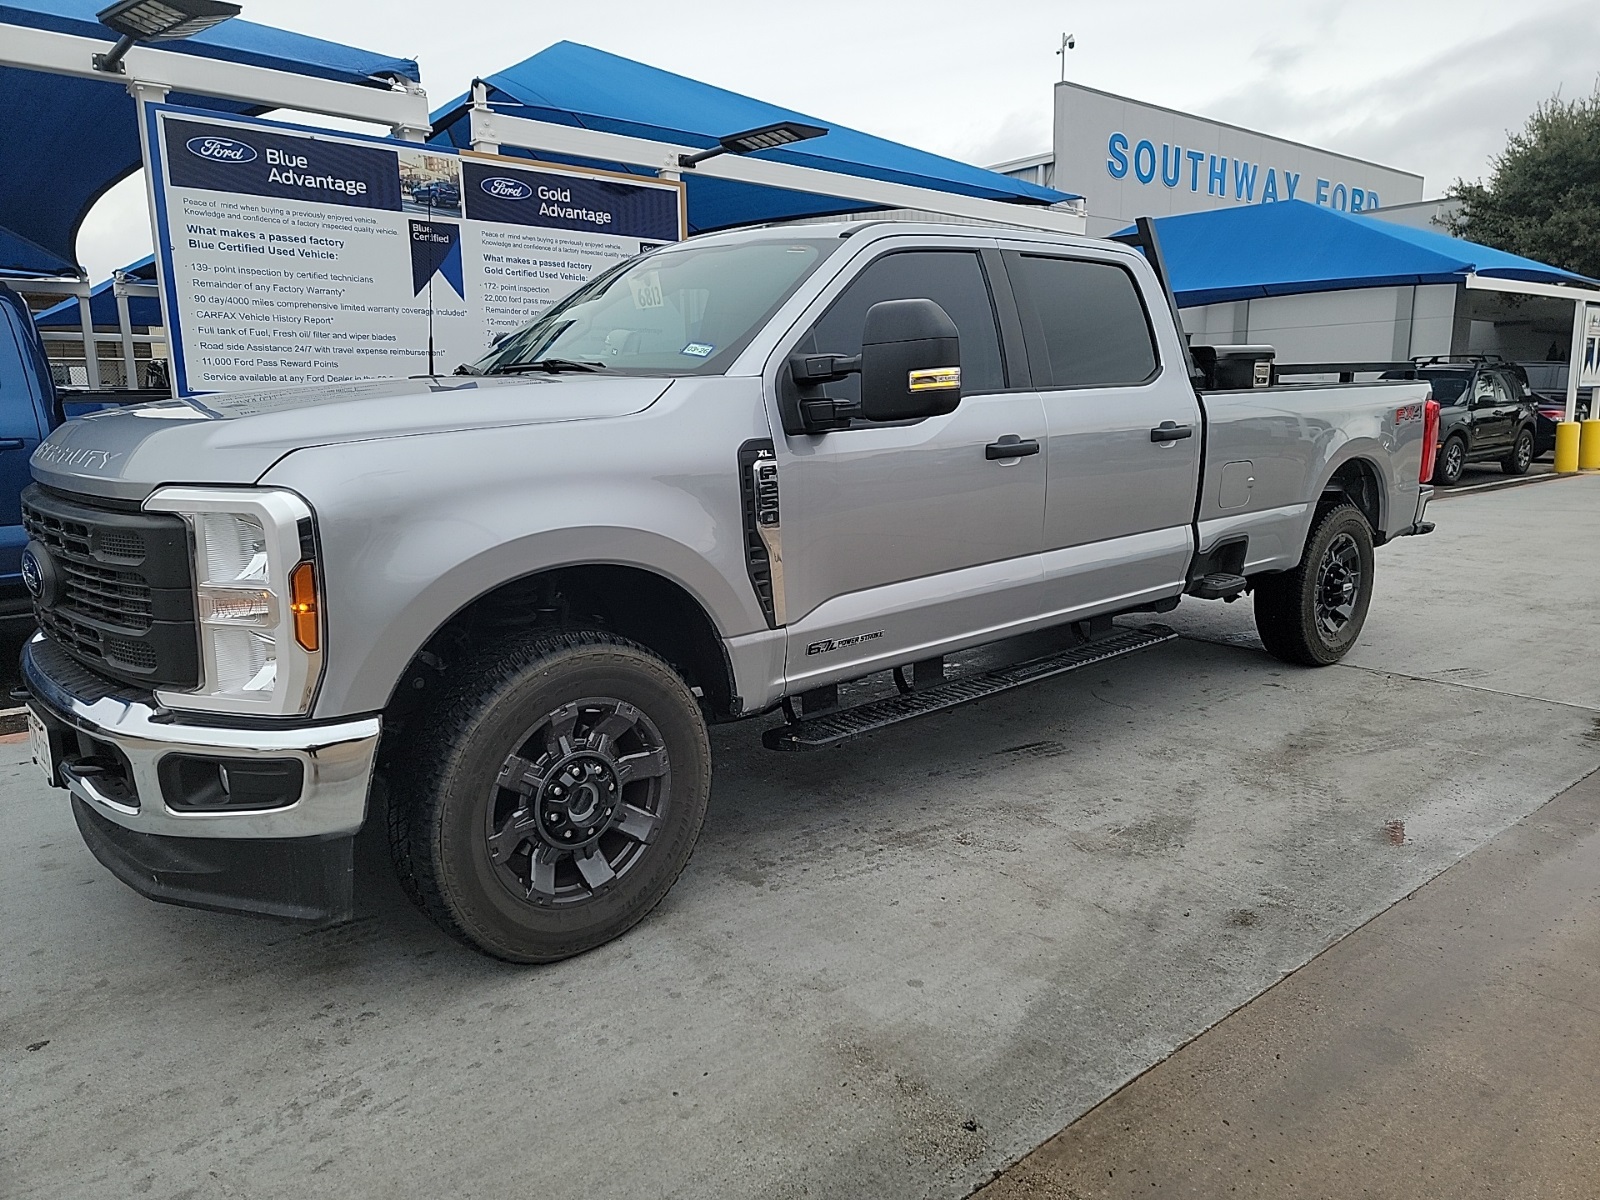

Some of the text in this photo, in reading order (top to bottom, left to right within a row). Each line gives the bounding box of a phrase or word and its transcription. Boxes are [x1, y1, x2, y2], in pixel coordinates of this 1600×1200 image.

[200, 138, 245, 160] Ford
[266, 148, 308, 168] Blue
[1106, 131, 1380, 214] SOUTHWAY FORD
[268, 167, 367, 196] Advantage
[490, 179, 523, 198] Ford
[538, 186, 571, 202] Gold
[183, 198, 207, 206] Peace
[220, 202, 238, 210] mind
[240, 204, 259, 212] when
[261, 206, 284, 216] buying
[292, 210, 326, 220] previously
[328, 214, 352, 222] enjoyed
[539, 202, 612, 224] Advantage
[184, 208, 226, 219] Knowledge
[228, 212, 240, 220] and
[243, 214, 280, 224] confidence
[297, 220, 320, 228] factory
[322, 222, 352, 232] inspected
[354, 226, 374, 234] quality
[412, 224, 432, 233] Blue
[186, 224, 217, 236] What
[220, 229, 256, 239] makes
[269, 234, 306, 244] passed
[310, 236, 344, 248] factory
[413, 232, 449, 243] Certified
[537, 236, 553, 244] buying
[559, 239, 584, 247] previously
[585, 242, 603, 250] enjoyed
[188, 240, 338, 260] Blue Certified Used Vehicle:
[482, 239, 511, 248] Knowledge
[524, 244, 551, 252] confidence
[563, 247, 579, 255] factory
[483, 254, 503, 262] What
[539, 260, 565, 268] passed
[567, 263, 592, 271] factory
[191, 263, 374, 283] 139- point inspection by certified technicians
[484, 267, 588, 281] Gold Certified Used Vehicle:
[192, 278, 242, 289] Remainder
[244, 282, 252, 290] of
[255, 284, 270, 293] any
[272, 284, 304, 294] Factory
[484, 282, 499, 290] 172-
[518, 285, 550, 293] inspection
[194, 294, 206, 302] 90
[208, 296, 250, 305] day/4000
[252, 298, 274, 306] miles
[277, 300, 338, 310] comprehensive
[341, 303, 365, 312] limited
[368, 306, 399, 314] warranty
[402, 307, 434, 316] coverage
[484, 294, 507, 302] 22,000
[196, 310, 236, 320] CARFAX
[239, 312, 270, 322] Vehicle
[273, 315, 301, 324] History
[198, 326, 214, 334] Full
[217, 328, 237, 336] tank
[238, 328, 247, 336] of
[273, 330, 297, 338] Fresh
[313, 331, 330, 339] filter
[349, 333, 370, 341] wiper
[200, 342, 224, 350] Road
[246, 344, 292, 352] Assistance
[295, 345, 312, 353] 24/7
[314, 345, 331, 353] with
[356, 348, 388, 356] expense
[202, 358, 232, 366] 11,000
[234, 358, 254, 366] Ford
[256, 359, 278, 367] Pass
[280, 360, 311, 368] Reward
[203, 373, 237, 381] Service
[239, 373, 277, 381] available
[289, 375, 304, 383] any
[1395, 403, 1423, 425] FX4
[757, 450, 772, 458] XL
[806, 638, 836, 656] 6.7L
[838, 637, 860, 648] POWER
